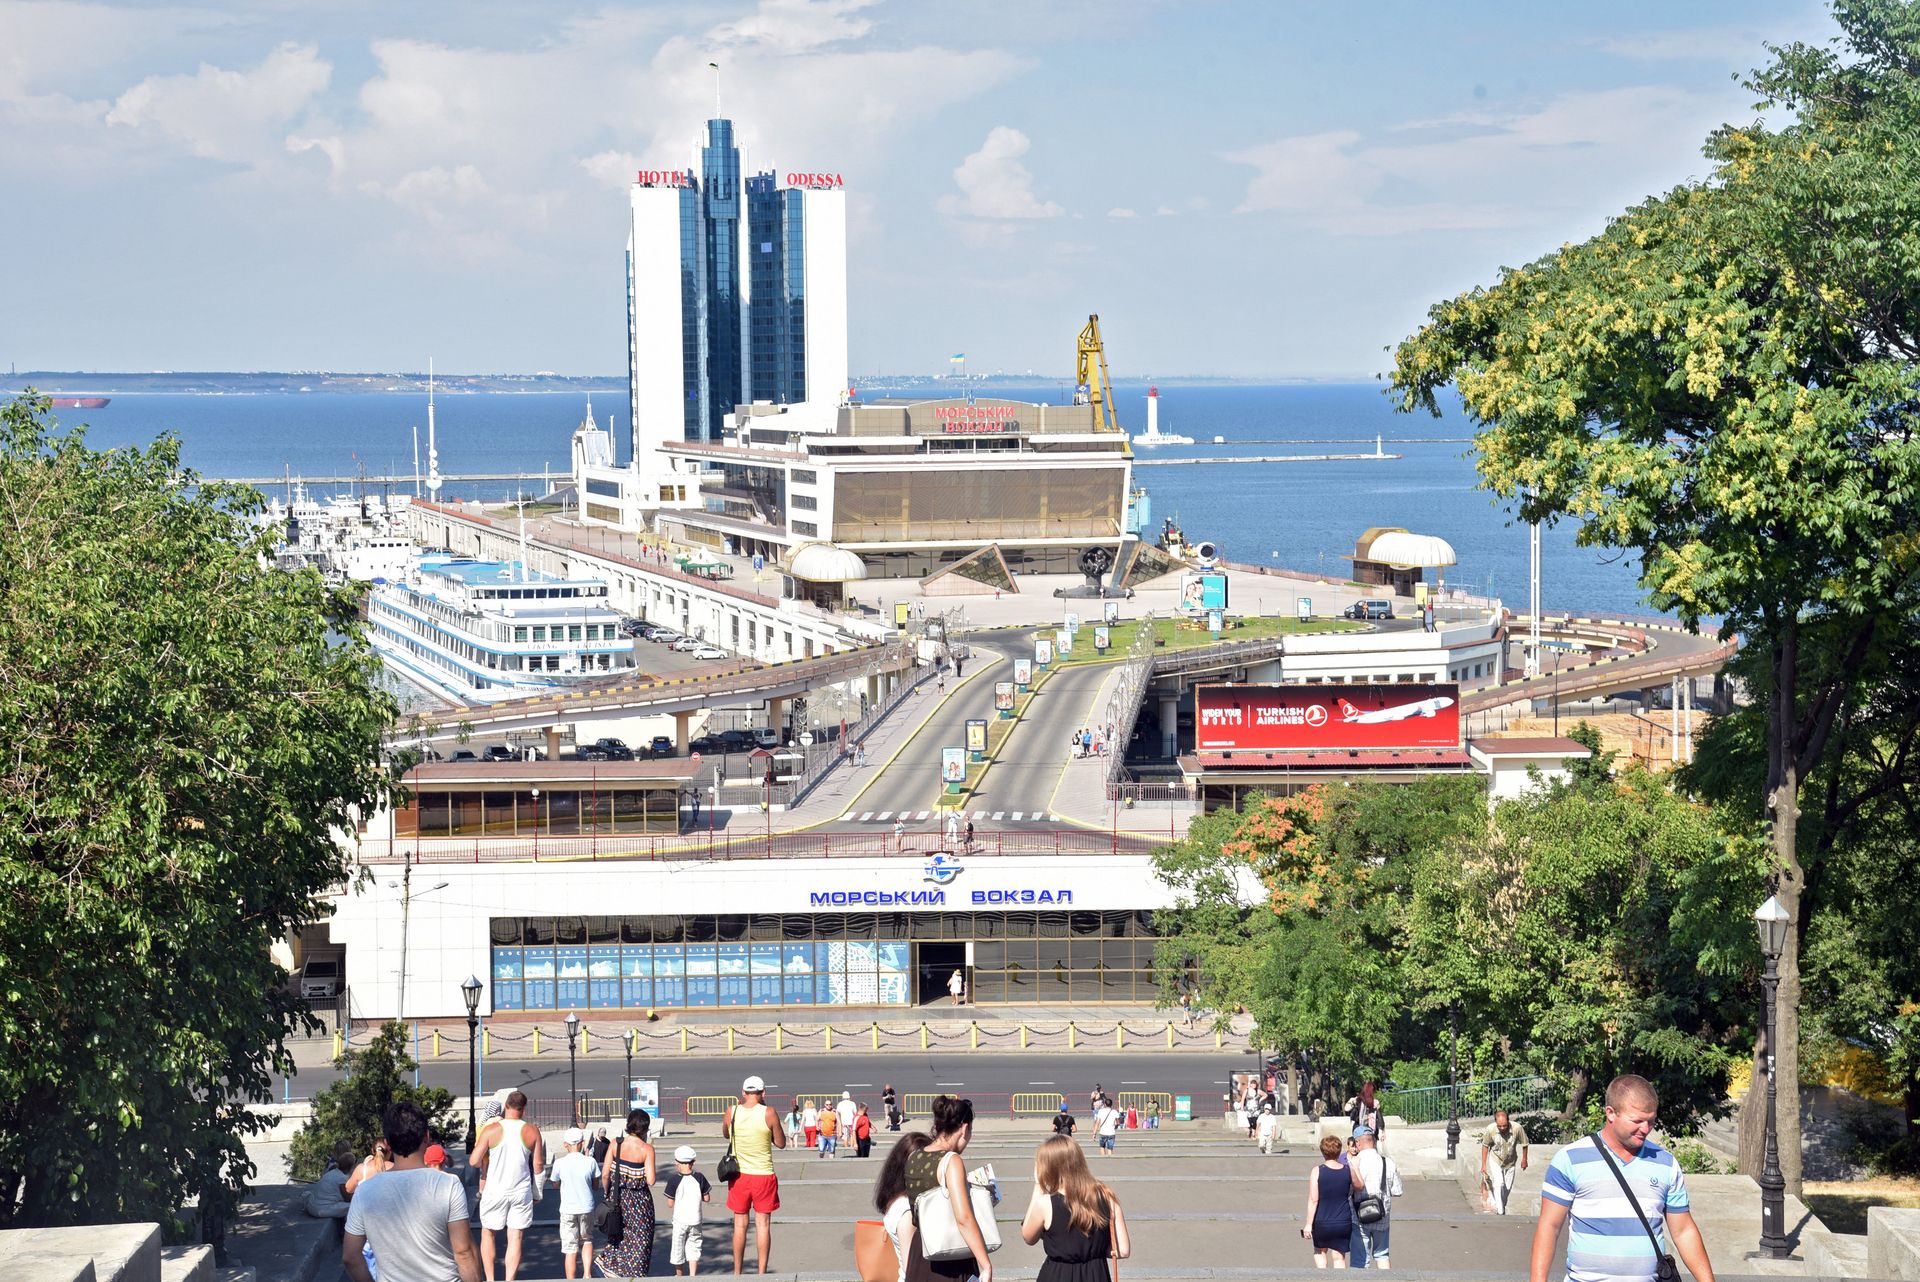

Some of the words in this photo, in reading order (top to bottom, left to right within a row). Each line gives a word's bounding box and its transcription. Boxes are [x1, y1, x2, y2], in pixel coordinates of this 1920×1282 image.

[638, 170, 687, 184] HOTEL
[786, 172, 843, 186] ODESSA
[946, 421, 1005, 433] ВОКЗАЛ
[1202, 708, 1223, 718] WIDEN
[1225, 708, 1242, 717] YOUR
[1256, 707, 1304, 716] TURKISH
[1202, 717, 1242, 725] WORLD
[1256, 716, 1304, 725] AIRLINES
[810, 887, 945, 905] МОРСЬКИЙ
[971, 889, 1073, 904] ВОКЗАЛ
